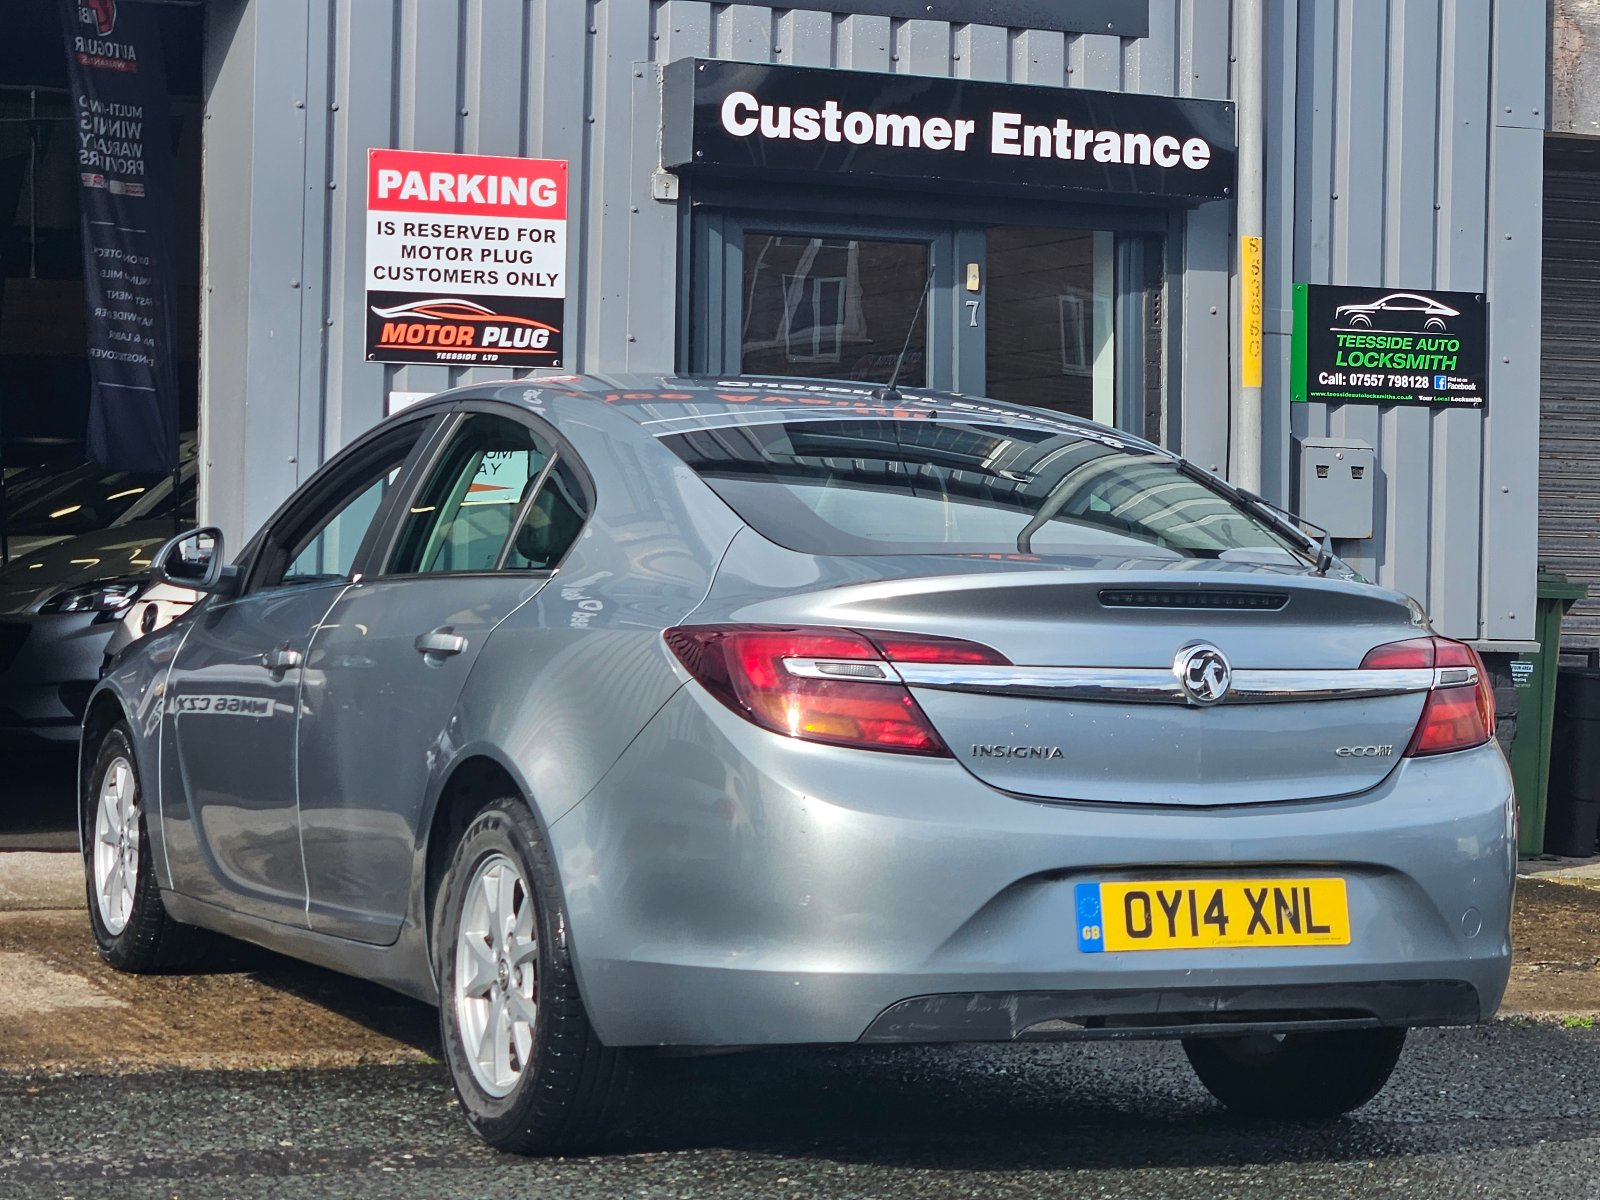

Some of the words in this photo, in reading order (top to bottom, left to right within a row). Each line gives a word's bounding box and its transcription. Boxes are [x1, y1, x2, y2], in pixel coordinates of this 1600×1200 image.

[720, 90, 976, 152] Customer
[990, 111, 1212, 171] Entrance
[377, 169, 558, 207] PARKING
[376, 221, 396, 236] IS
[403, 223, 510, 241] RESERVED
[517, 228, 557, 244] FOR
[401, 244, 473, 262] MOTOR
[480, 248, 533, 265] PLUG
[373, 265, 499, 285] CUSTOMERS
[506, 271, 559, 288] ONLY
[965, 300, 980, 327] 7
[381, 322, 475, 346] MOTOR
[481, 326, 550, 349] PLUG
[1336, 334, 1413, 350] TEESSIDE
[1415, 338, 1460, 352] AUTO
[436, 352, 477, 361] TEESSIDE
[482, 353, 499, 362] LTD
[1335, 350, 1457, 371] LOCKSMITH
[1318, 372, 1347, 386] Call:
[1349, 373, 1385, 387] 07557
[1387, 375, 1429, 389] 798128
[1447, 382, 1476, 390] Facebook
[972, 743, 1065, 760] INSIGNIA
[1123, 888, 1230, 939] OY14
[1243, 887, 1331, 935] XNL
[1081, 925, 1100, 941] GB
